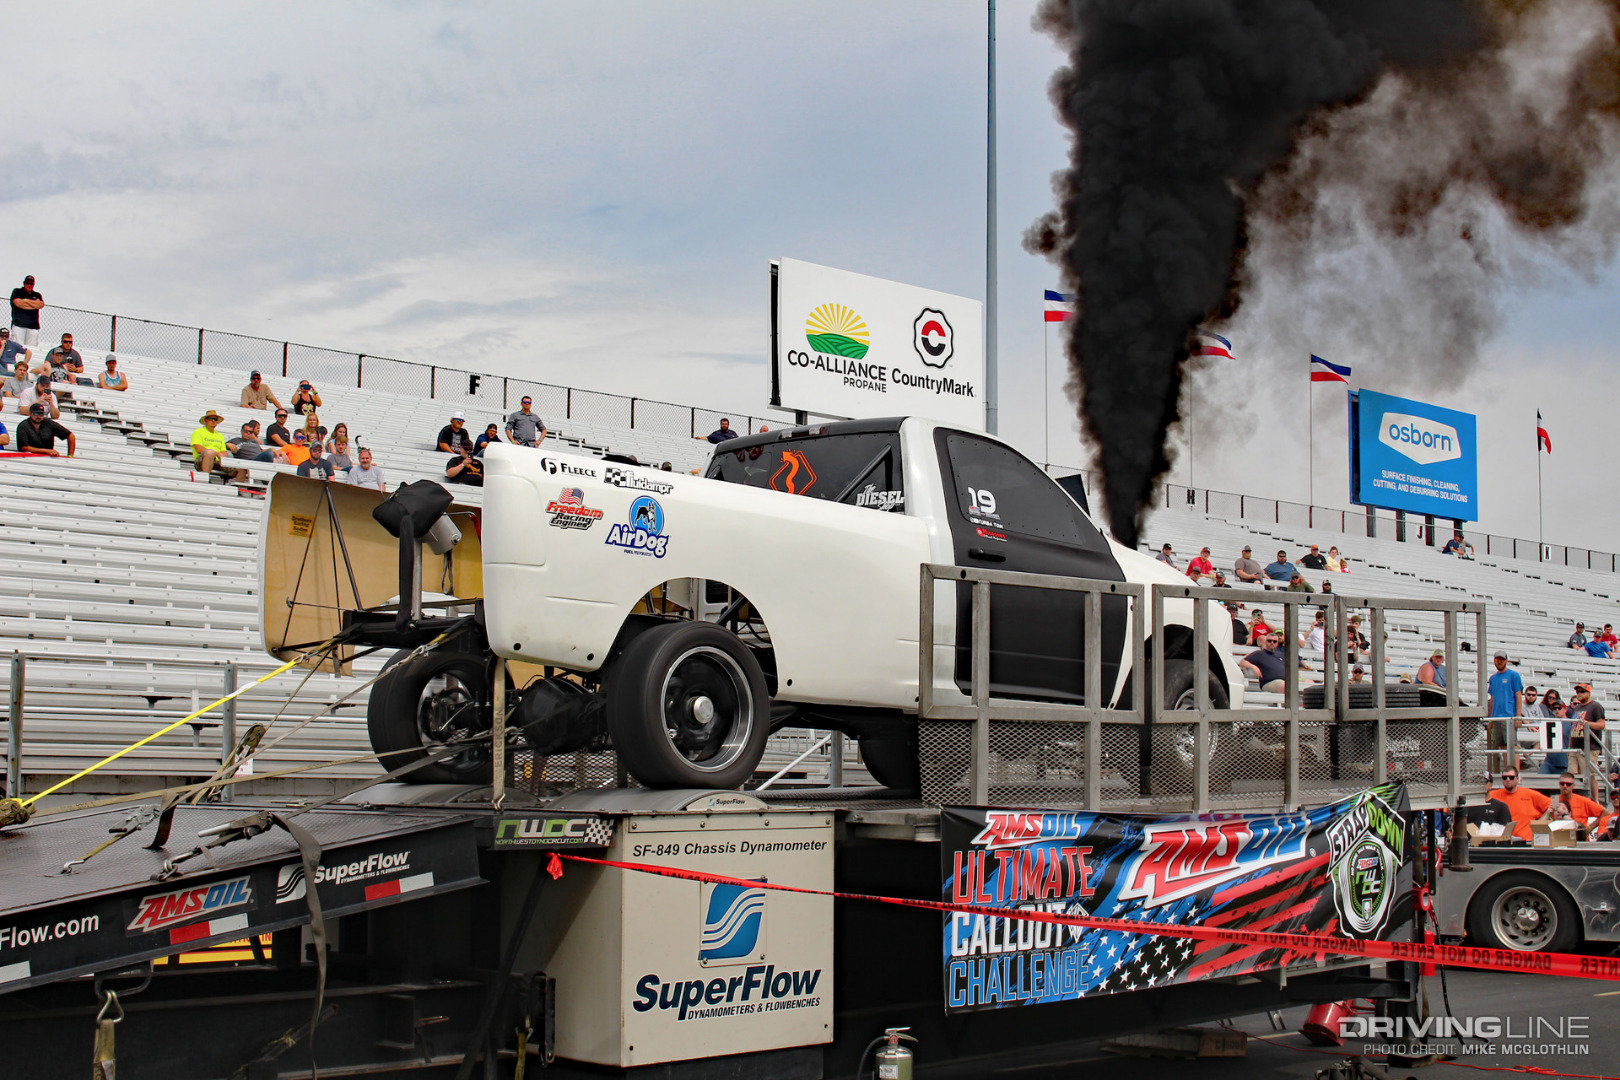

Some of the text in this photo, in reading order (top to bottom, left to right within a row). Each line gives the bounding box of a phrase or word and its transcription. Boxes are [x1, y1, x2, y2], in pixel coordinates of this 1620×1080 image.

[787, 350, 887, 382] CO-ALLIANCE
[469, 375, 481, 395] F
[843, 376, 887, 393] PROPANE
[892, 368, 975, 397] CountryMark
[1389, 423, 1452, 451] osborn
[560, 463, 597, 478] FLEECE
[1382, 470, 1460, 492] SURFACE FINISHING, CLEANING,
[856, 490, 904, 506] DIESEL
[967, 486, 997, 514] 19
[1187, 489, 1195, 504] H
[1373, 479, 1468, 503] CUTTING, AND DEBURRING SOLUTIONS
[547, 501, 603, 518] Freedom
[550, 517, 588, 528] Engines
[555, 512, 592, 525] Racing
[605, 523, 669, 558] AirDog
[1417, 525, 1423, 539] J
[1546, 722, 1556, 749] F
[971, 810, 1082, 850] AMSOIL
[1367, 801, 1403, 856] DOWN
[633, 840, 827, 857] SF-849 Chassis Dynamometer
[1117, 814, 1312, 909] AMSOIL
[314, 851, 409, 885] SuperFlow
[953, 846, 1095, 904] ULTIMATE
[128, 876, 252, 932] AMSOIL
[952, 902, 1066, 957] CALLOUT
[949, 948, 1090, 1008] CHALLENGE
[632, 964, 822, 1021] SuperFlow
[688, 997, 820, 1020] DYNAMOMETERS & FLOWBENCHES
